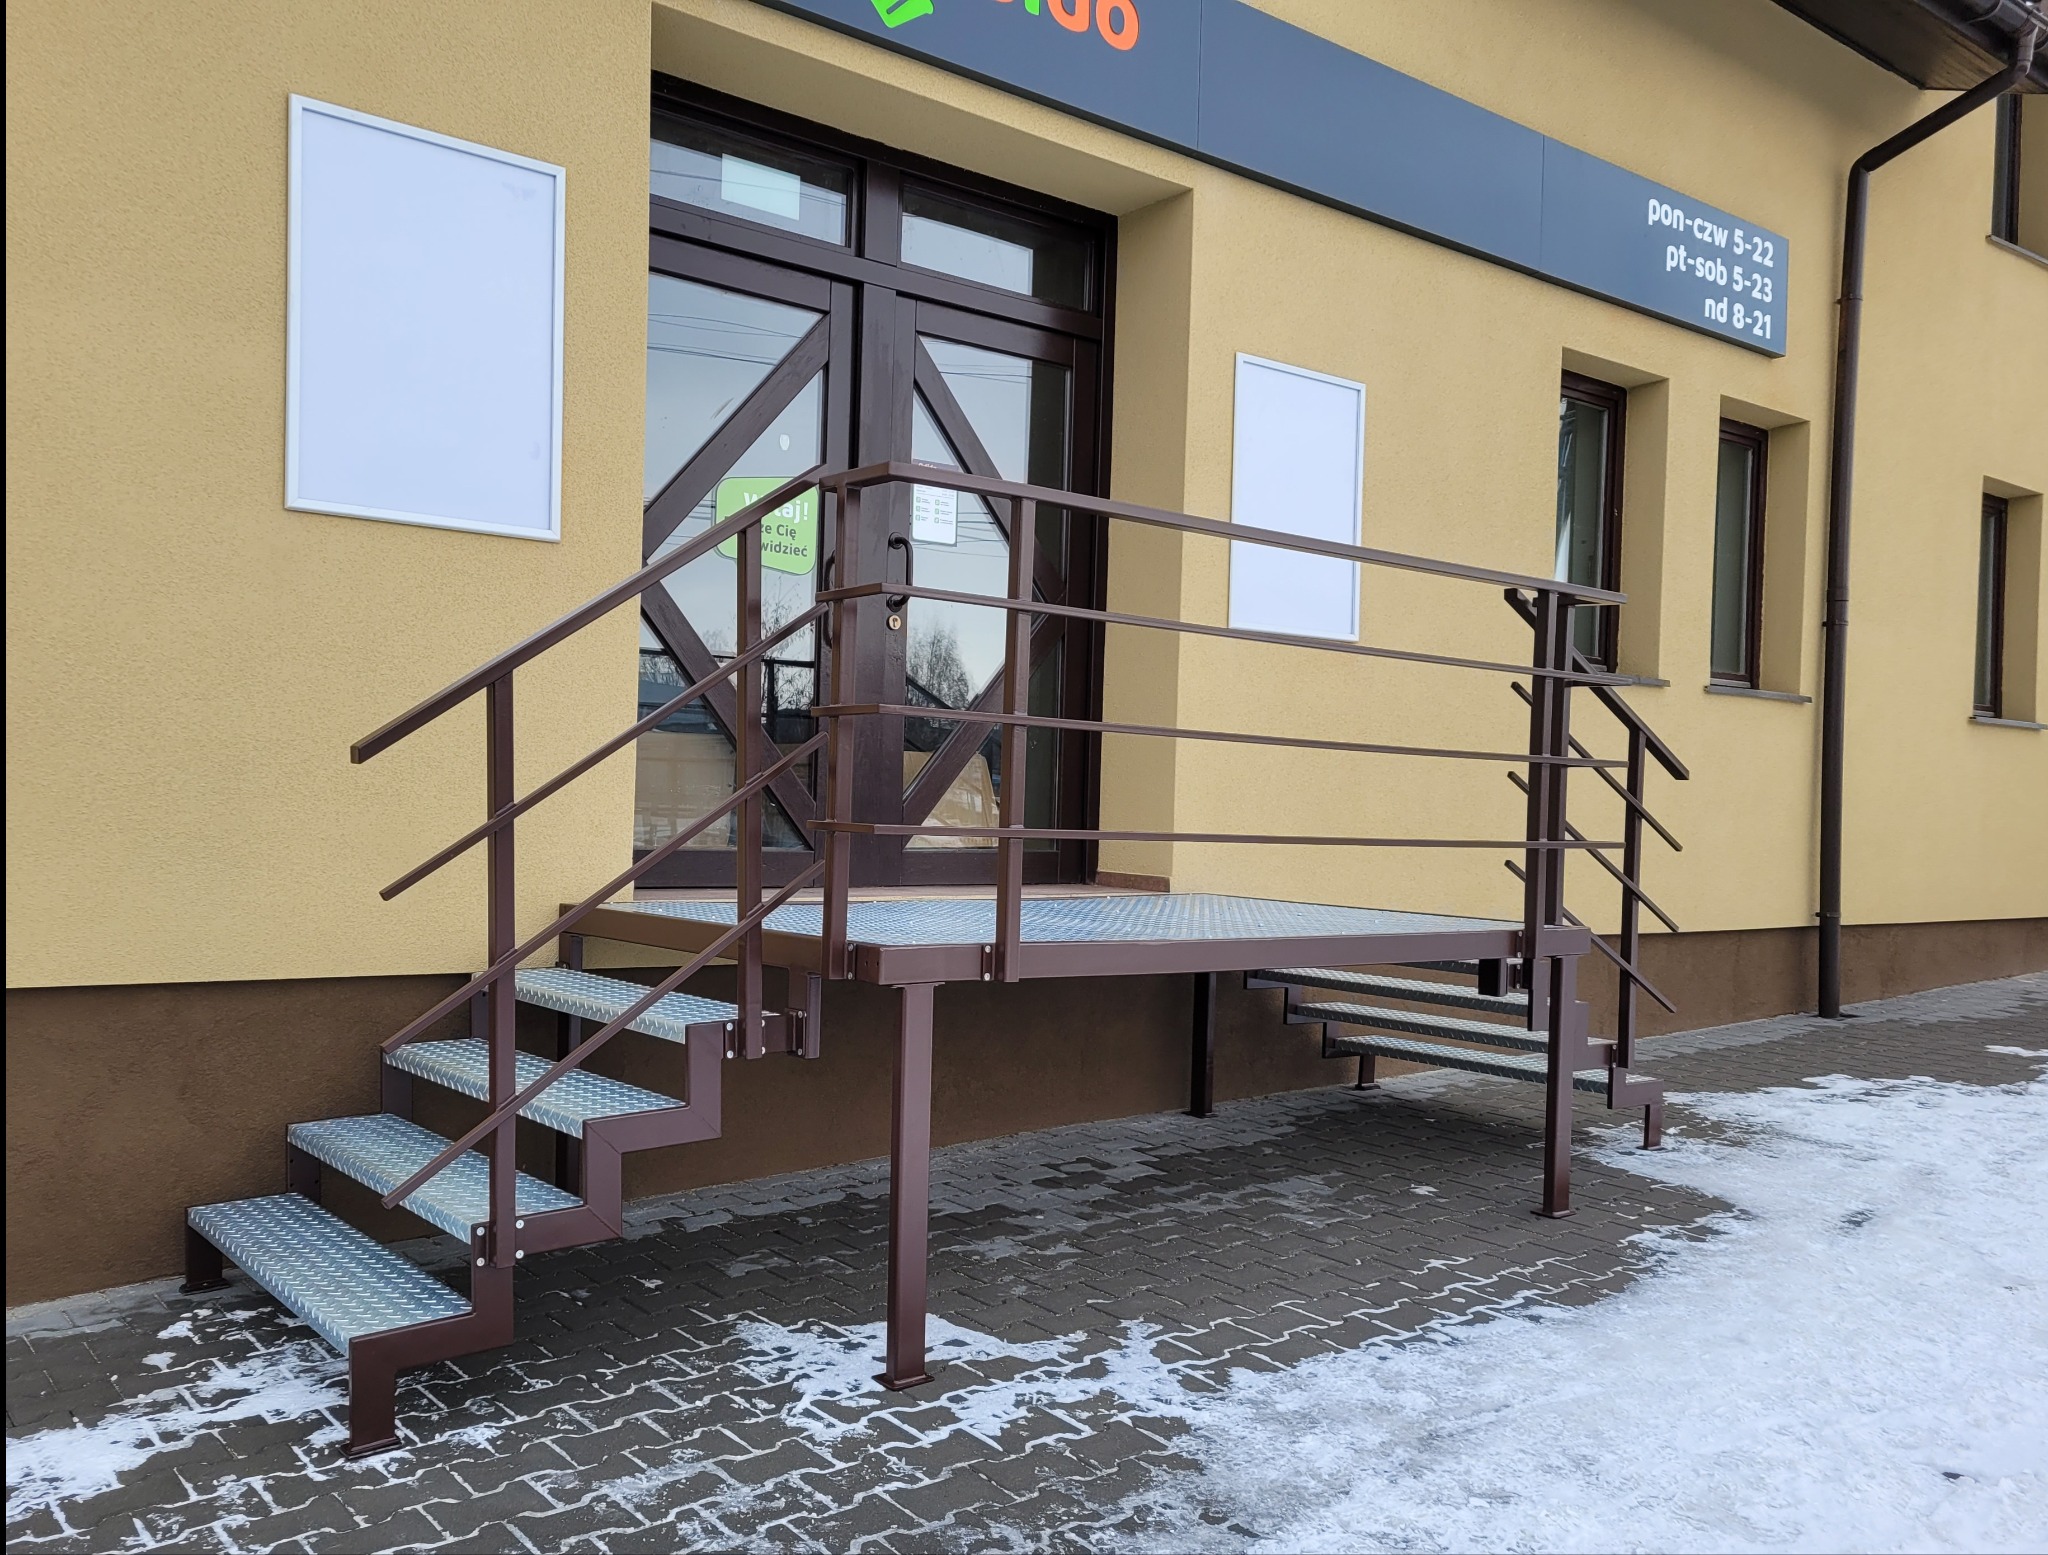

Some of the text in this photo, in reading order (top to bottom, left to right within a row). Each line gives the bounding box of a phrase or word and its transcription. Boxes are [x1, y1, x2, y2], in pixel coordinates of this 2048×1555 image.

[1648, 198, 1774, 268] pon-czw 5-22
[1666, 244, 1773, 303] pt-sob 5-23
[1704, 296, 1772, 340] nd 8-21
[743, 492, 809, 524] Wtaj!
[776, 524, 797, 541] Cię
